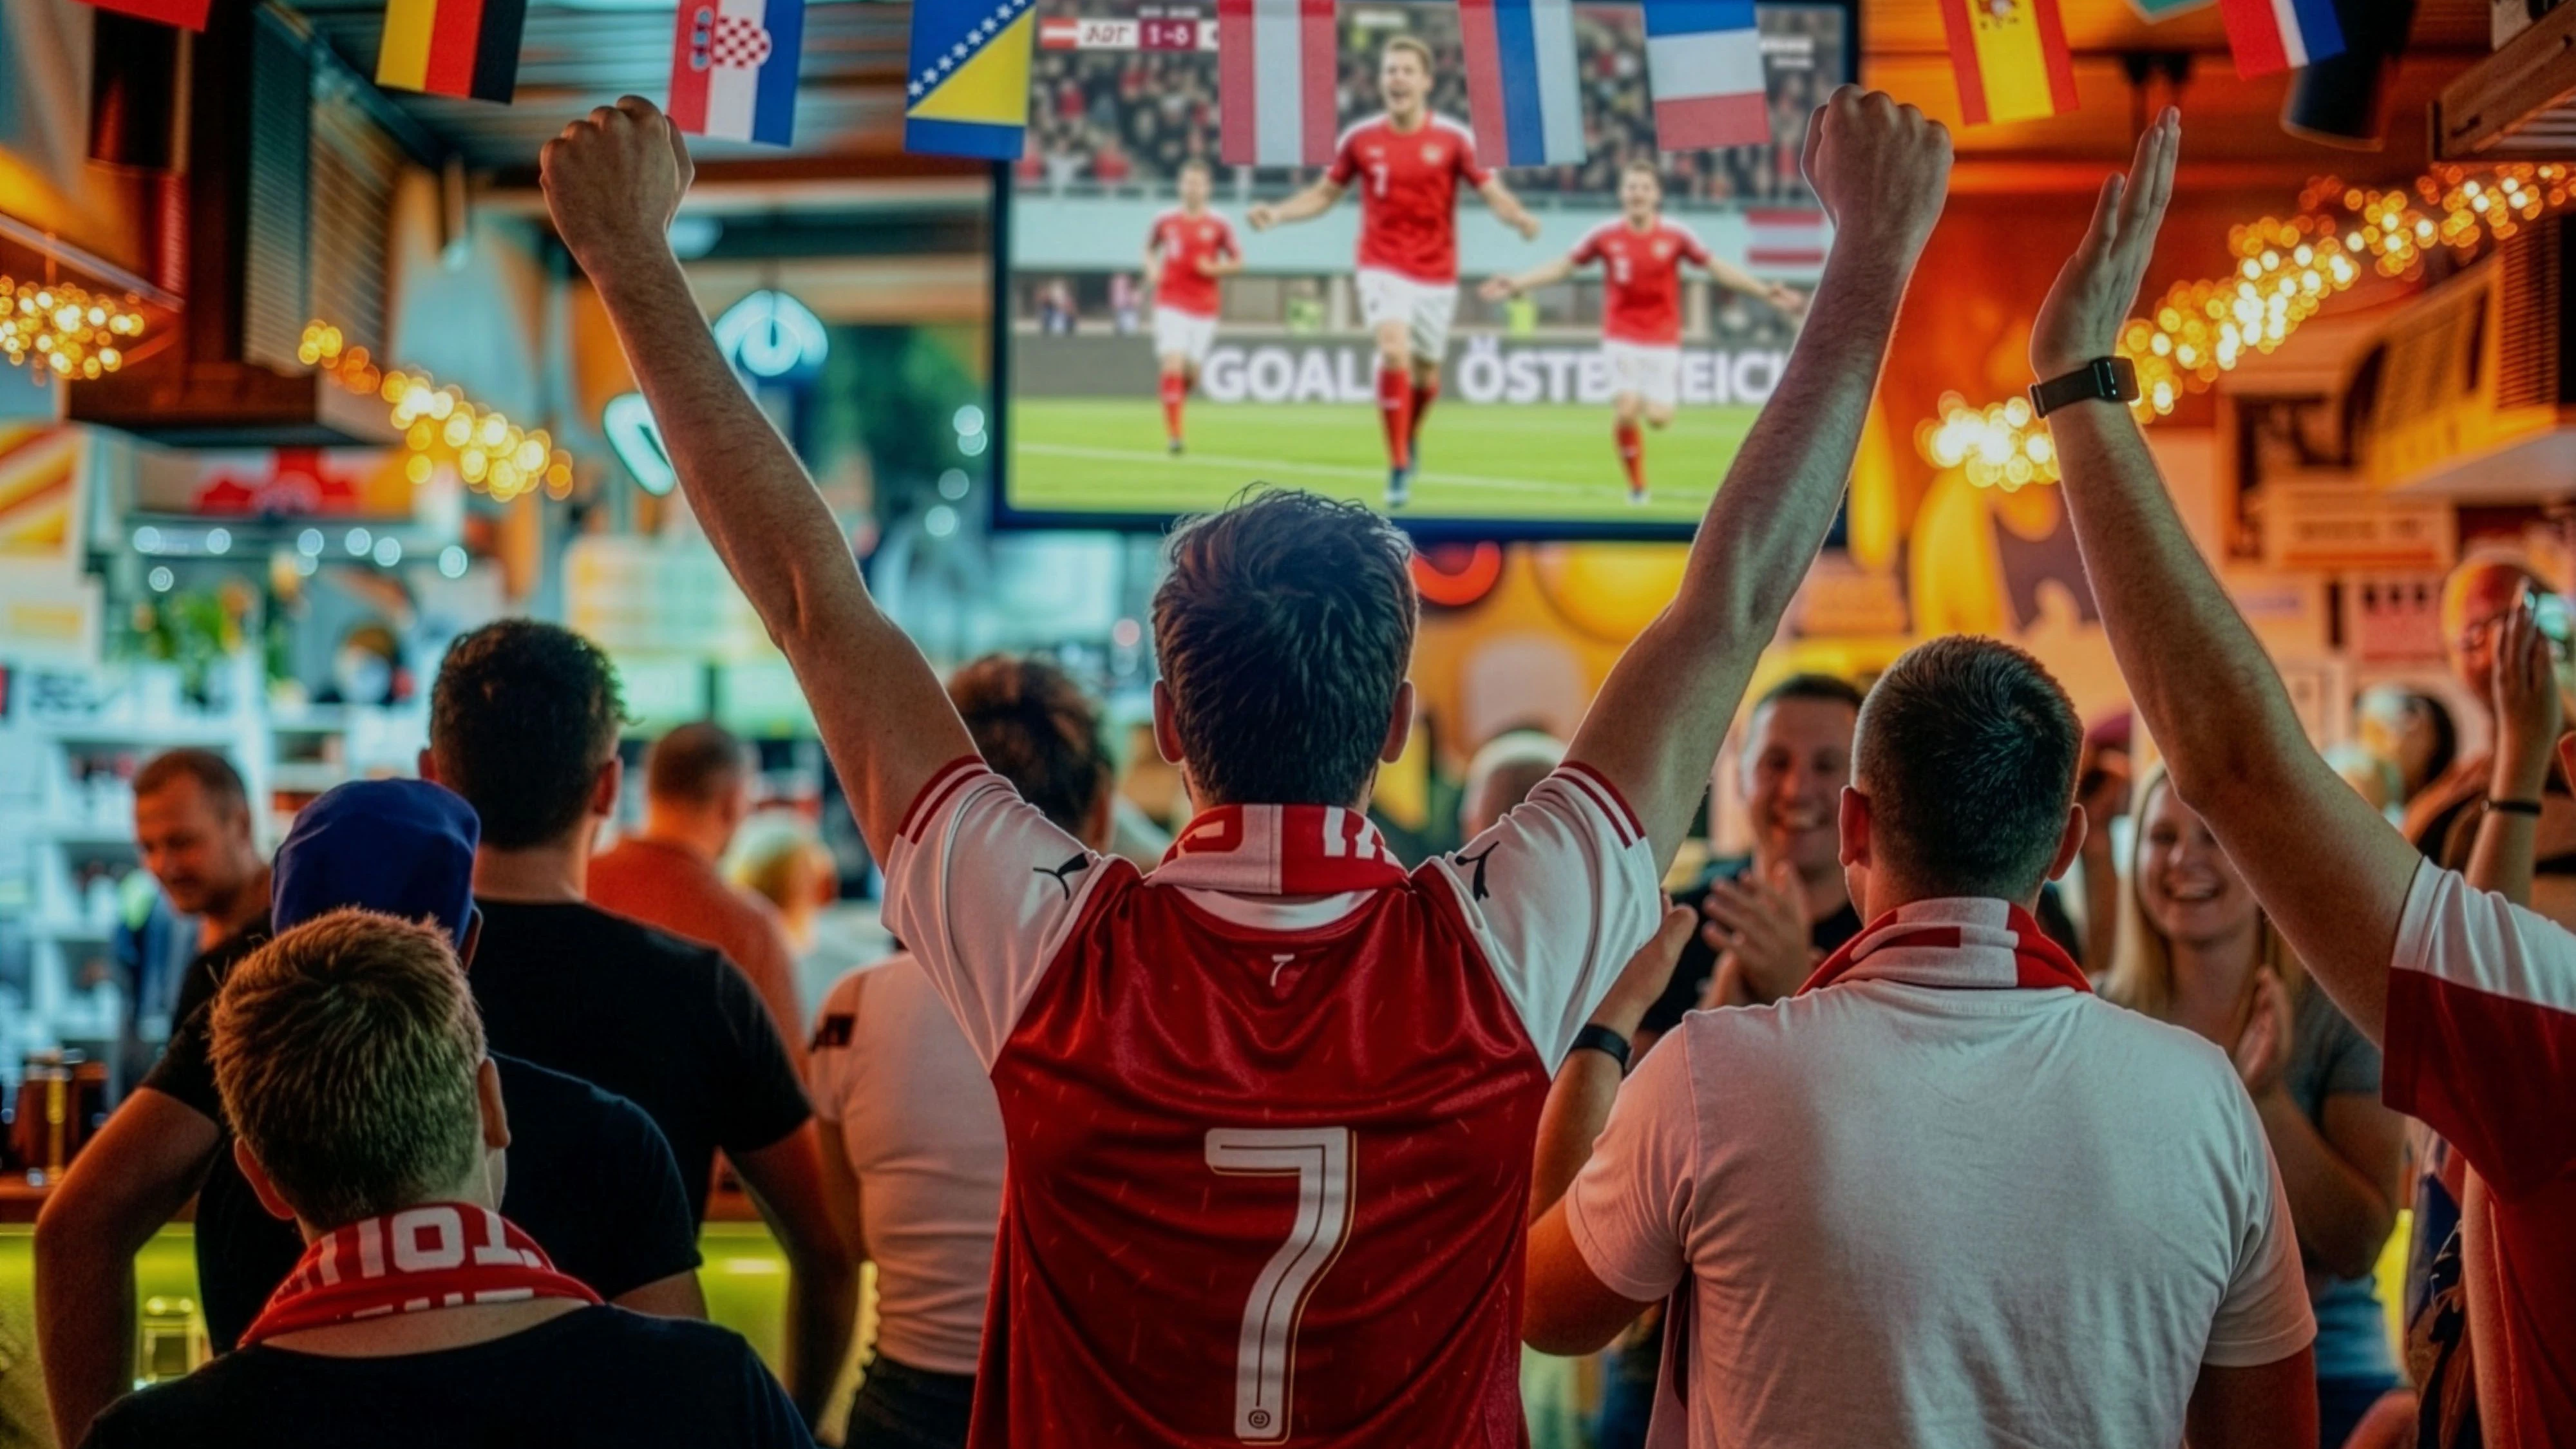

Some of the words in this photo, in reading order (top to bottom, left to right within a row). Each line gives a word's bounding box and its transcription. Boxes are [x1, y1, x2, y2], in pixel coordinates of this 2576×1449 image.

[1202, 346, 1380, 403] GOAL
[1457, 336, 1785, 403] ÖSTEEIC
[1270, 953, 1295, 987] 7
[1204, 1126, 1356, 1444] 7
